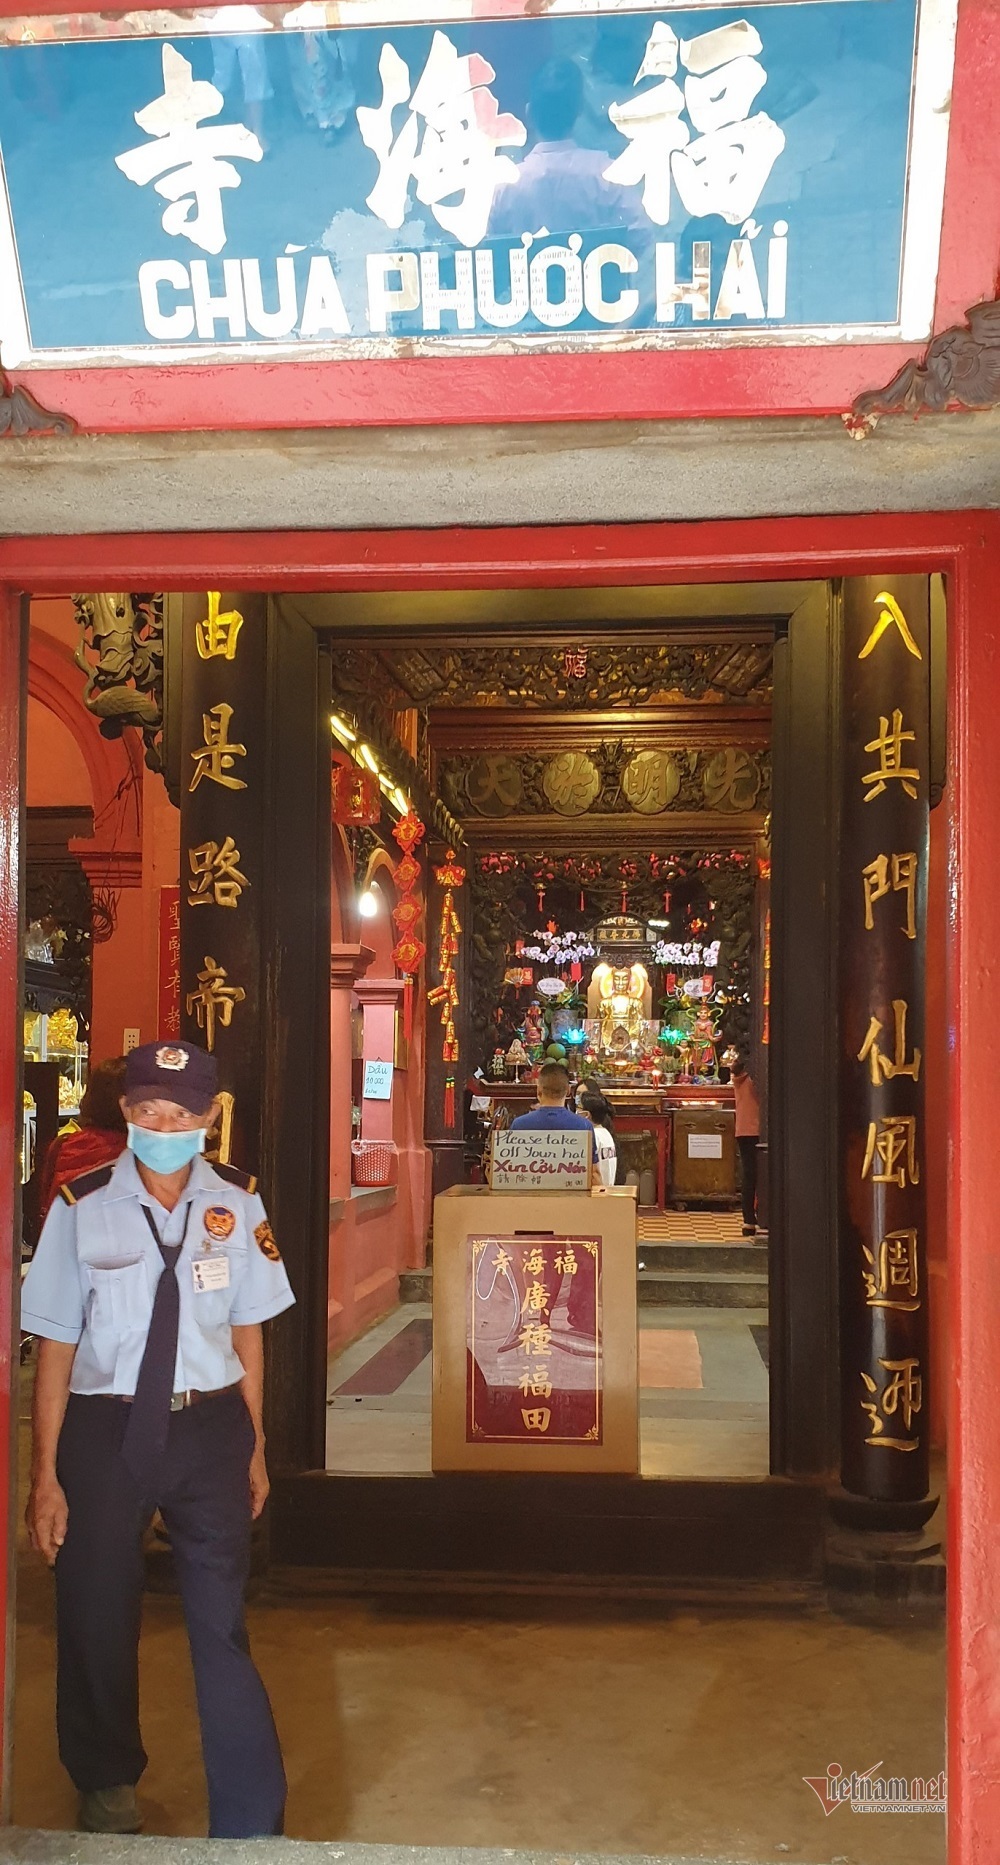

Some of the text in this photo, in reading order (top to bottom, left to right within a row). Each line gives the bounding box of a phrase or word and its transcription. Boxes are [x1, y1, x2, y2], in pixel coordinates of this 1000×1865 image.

[366, 226, 640, 332] PHƯỚC
[493, 1160, 528, 1173] Xin
[557, 1160, 587, 1174] Nón
[494, 1131, 578, 1146] Please take
[518, 1281, 553, 1433] 廣種福田
